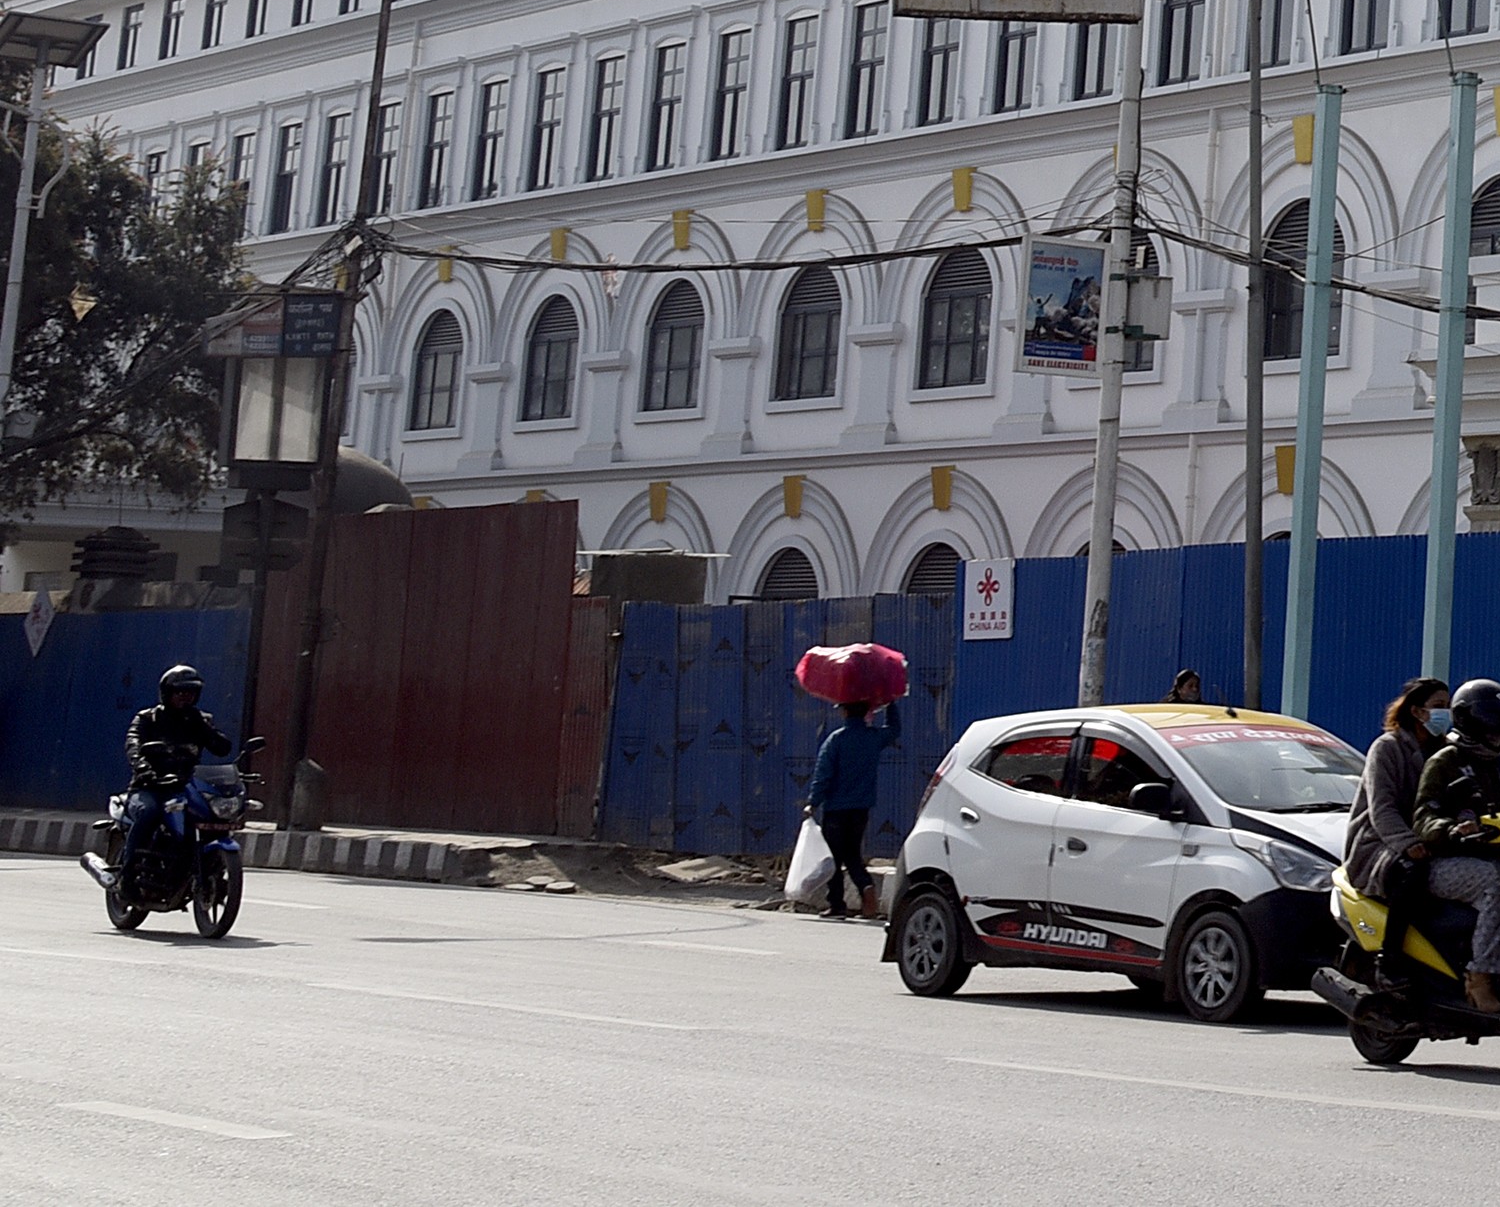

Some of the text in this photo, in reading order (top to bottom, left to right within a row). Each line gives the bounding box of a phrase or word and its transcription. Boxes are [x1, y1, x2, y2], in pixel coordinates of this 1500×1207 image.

[1046, 359, 1089, 370] ELECTRICITY
[969, 621, 1007, 631] CHINA AID
[1023, 922, 1108, 949] HYUNDAI
